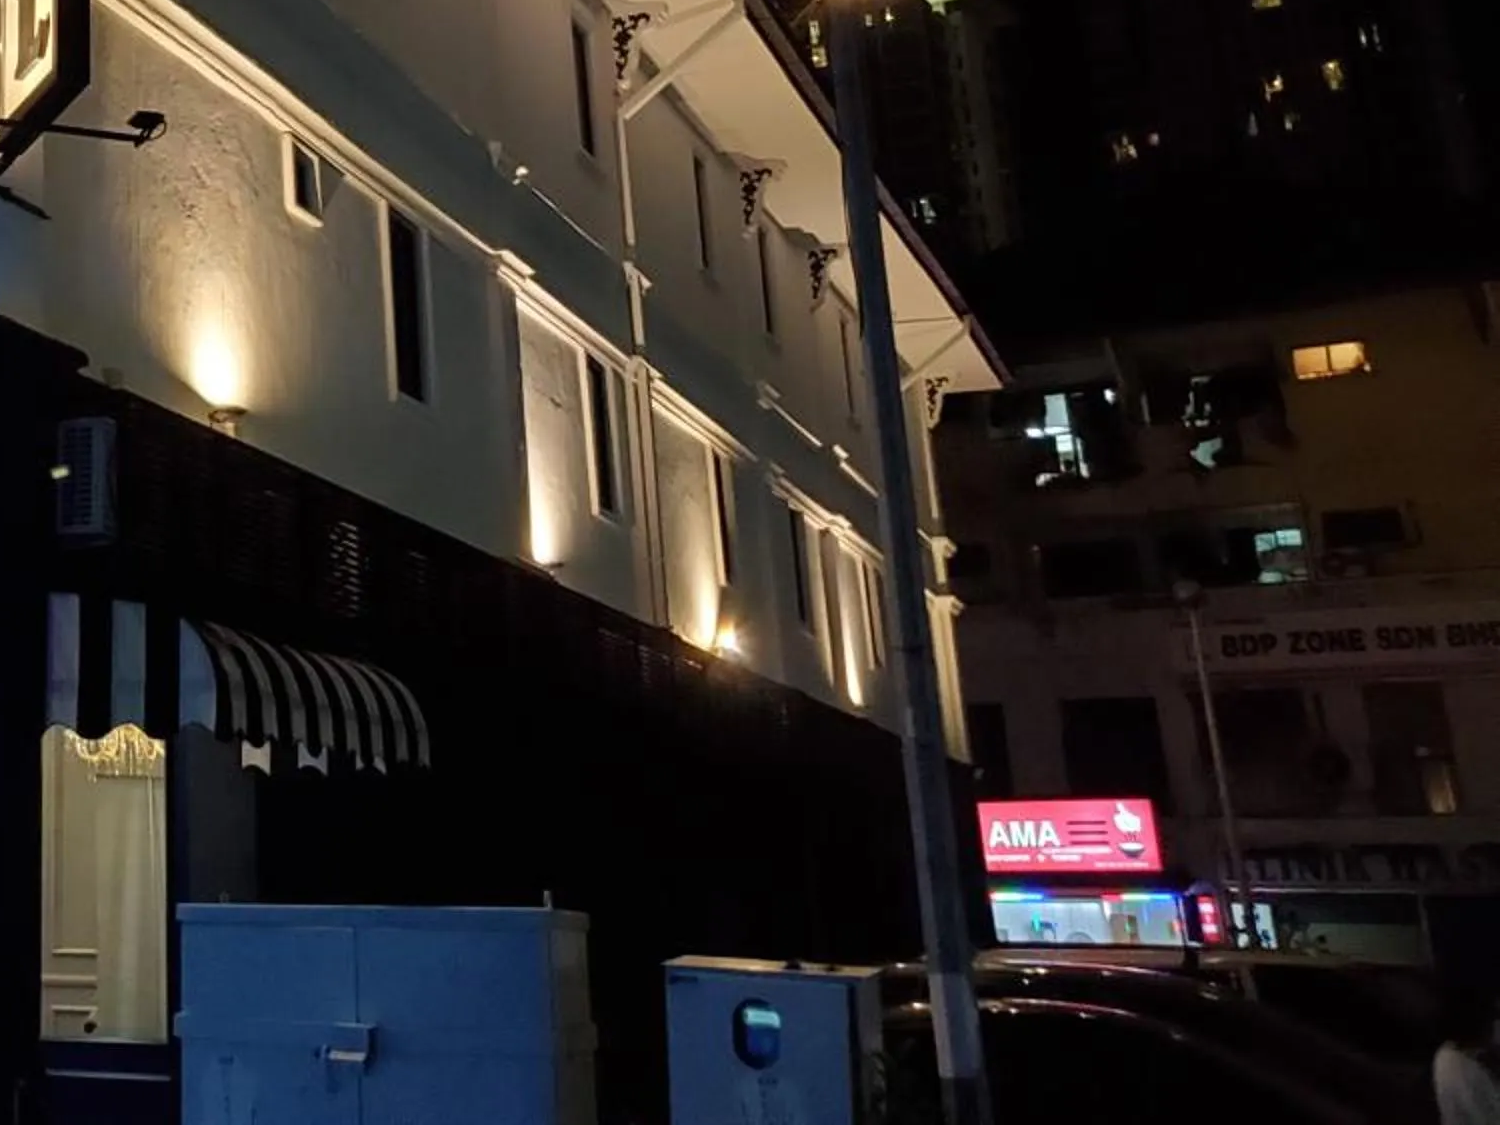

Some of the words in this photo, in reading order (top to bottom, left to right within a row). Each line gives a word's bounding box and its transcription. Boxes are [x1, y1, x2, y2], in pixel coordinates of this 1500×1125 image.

[1287, 627, 1367, 654] ZONE
[1375, 624, 1436, 651] SDN
[988, 819, 1061, 848] AMA
